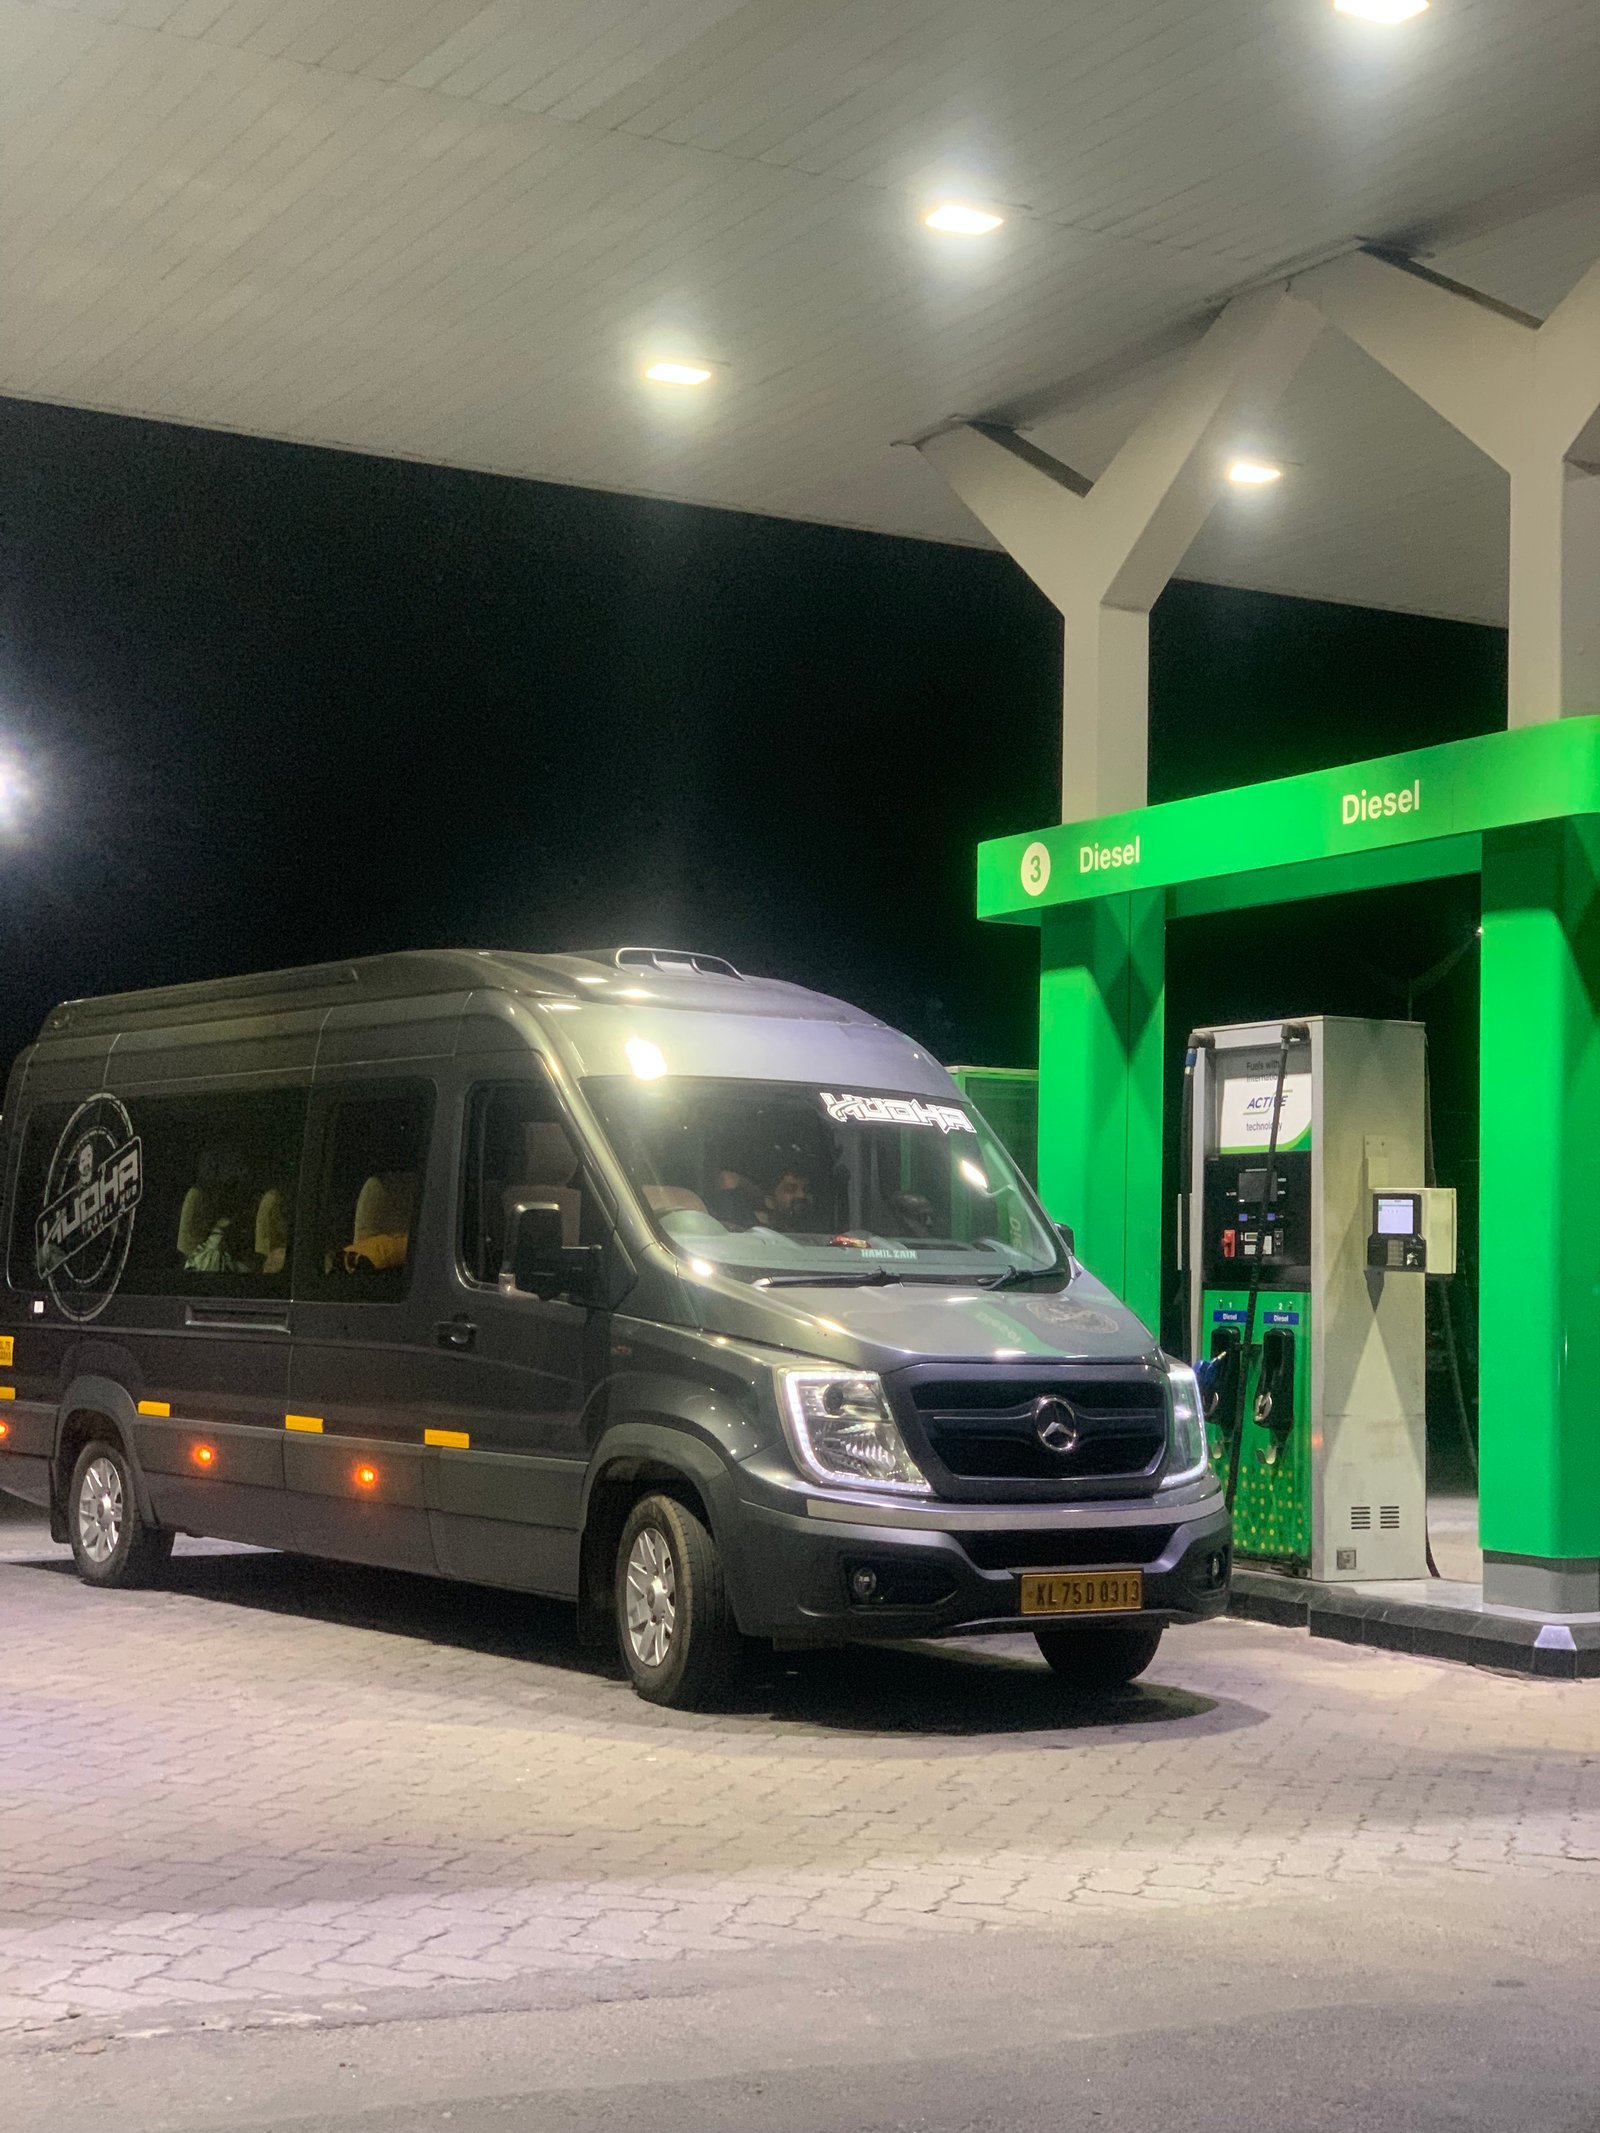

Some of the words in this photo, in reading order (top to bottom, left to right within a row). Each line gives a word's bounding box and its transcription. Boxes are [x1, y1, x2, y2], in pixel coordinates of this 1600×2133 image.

[1342, 779, 1420, 825] Diesel
[1030, 855, 1042, 883] 3
[1079, 835, 1140, 874] Diesel
[1246, 1096, 1288, 1110] ACTIE
